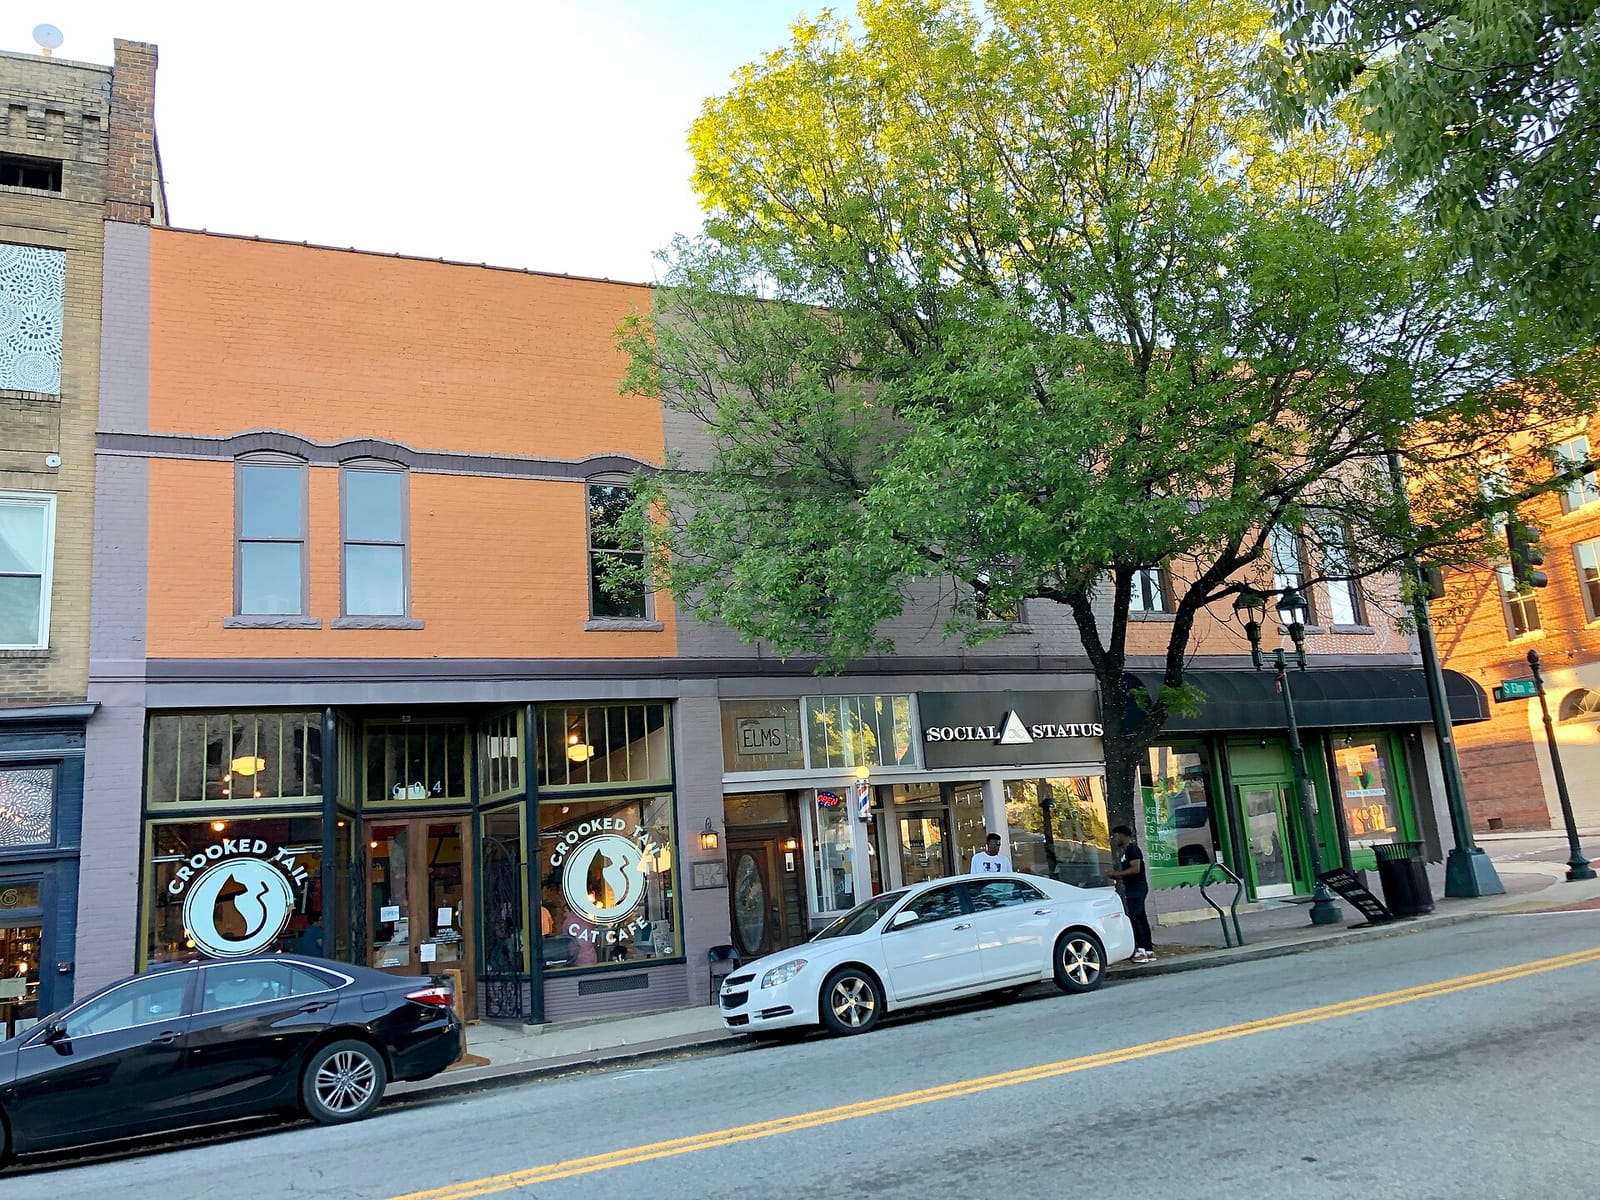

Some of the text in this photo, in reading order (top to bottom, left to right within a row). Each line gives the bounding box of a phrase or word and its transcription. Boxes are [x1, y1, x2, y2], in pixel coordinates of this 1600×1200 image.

[743, 728, 781, 748] ELMS
[926, 723, 1104, 742] SOCIAL STATUS
[817, 794, 838, 807] OPEN
[550, 817, 626, 867] CROOKED
[168, 838, 308, 895] CROOKED TAIL
[568, 915, 648, 944] CAT CAFE
